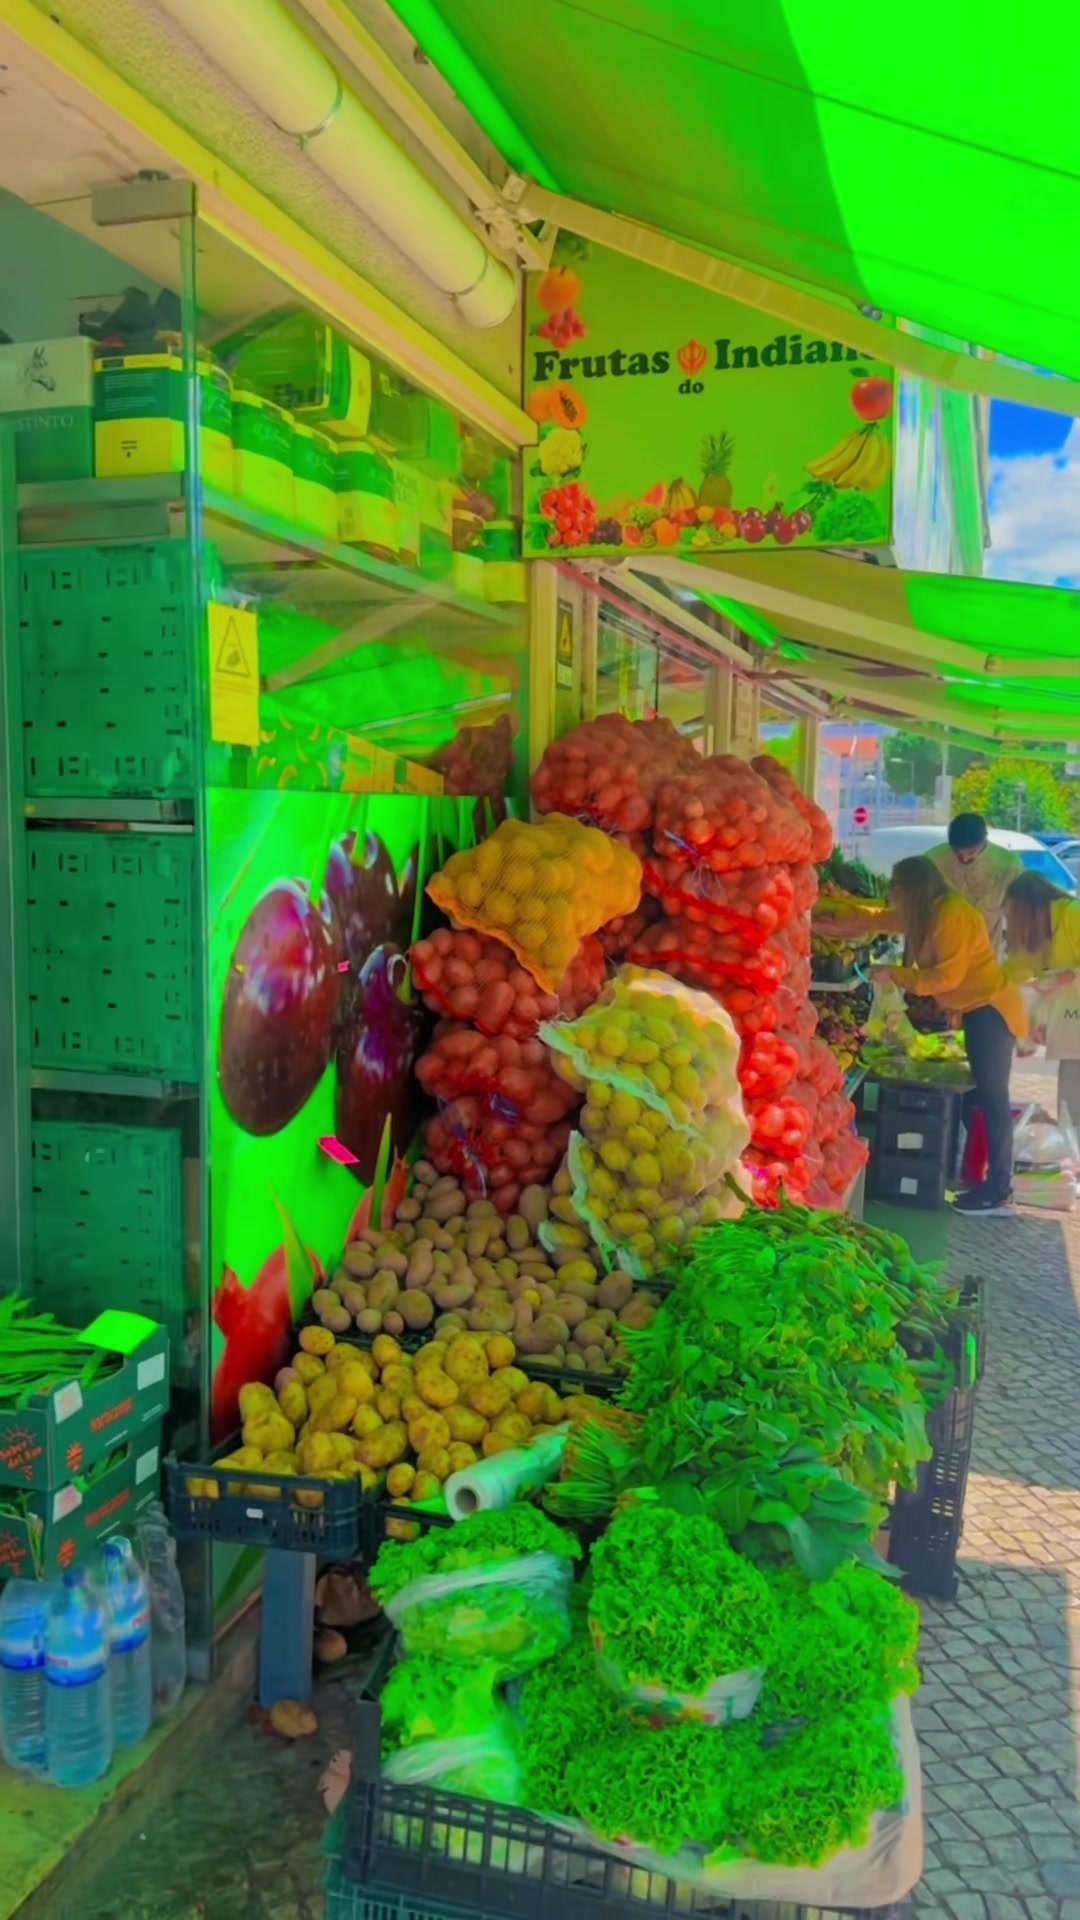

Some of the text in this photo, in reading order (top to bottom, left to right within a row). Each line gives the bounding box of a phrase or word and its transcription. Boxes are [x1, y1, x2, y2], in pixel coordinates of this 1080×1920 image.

[532, 334, 876, 382] Frutas Indian
[678, 378, 705, 395] do
